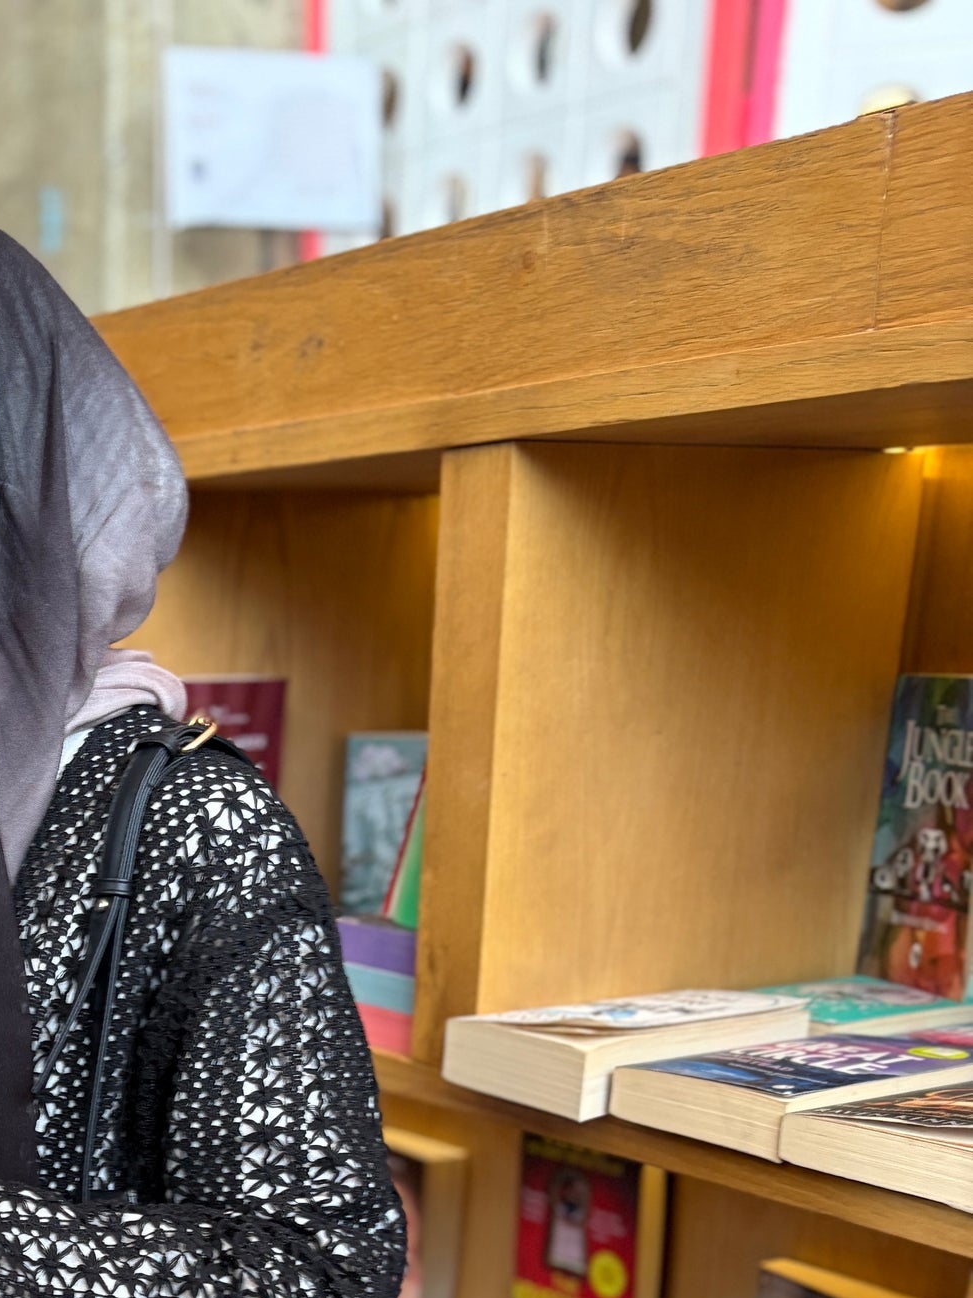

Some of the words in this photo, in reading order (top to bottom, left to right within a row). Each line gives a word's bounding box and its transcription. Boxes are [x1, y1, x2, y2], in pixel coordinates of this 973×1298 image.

[896, 718, 973, 769] JUNGLE
[902, 760, 970, 810] BOOK
[728, 1047, 889, 1076] CIRCLE
[774, 1040, 925, 1065] GREAT
